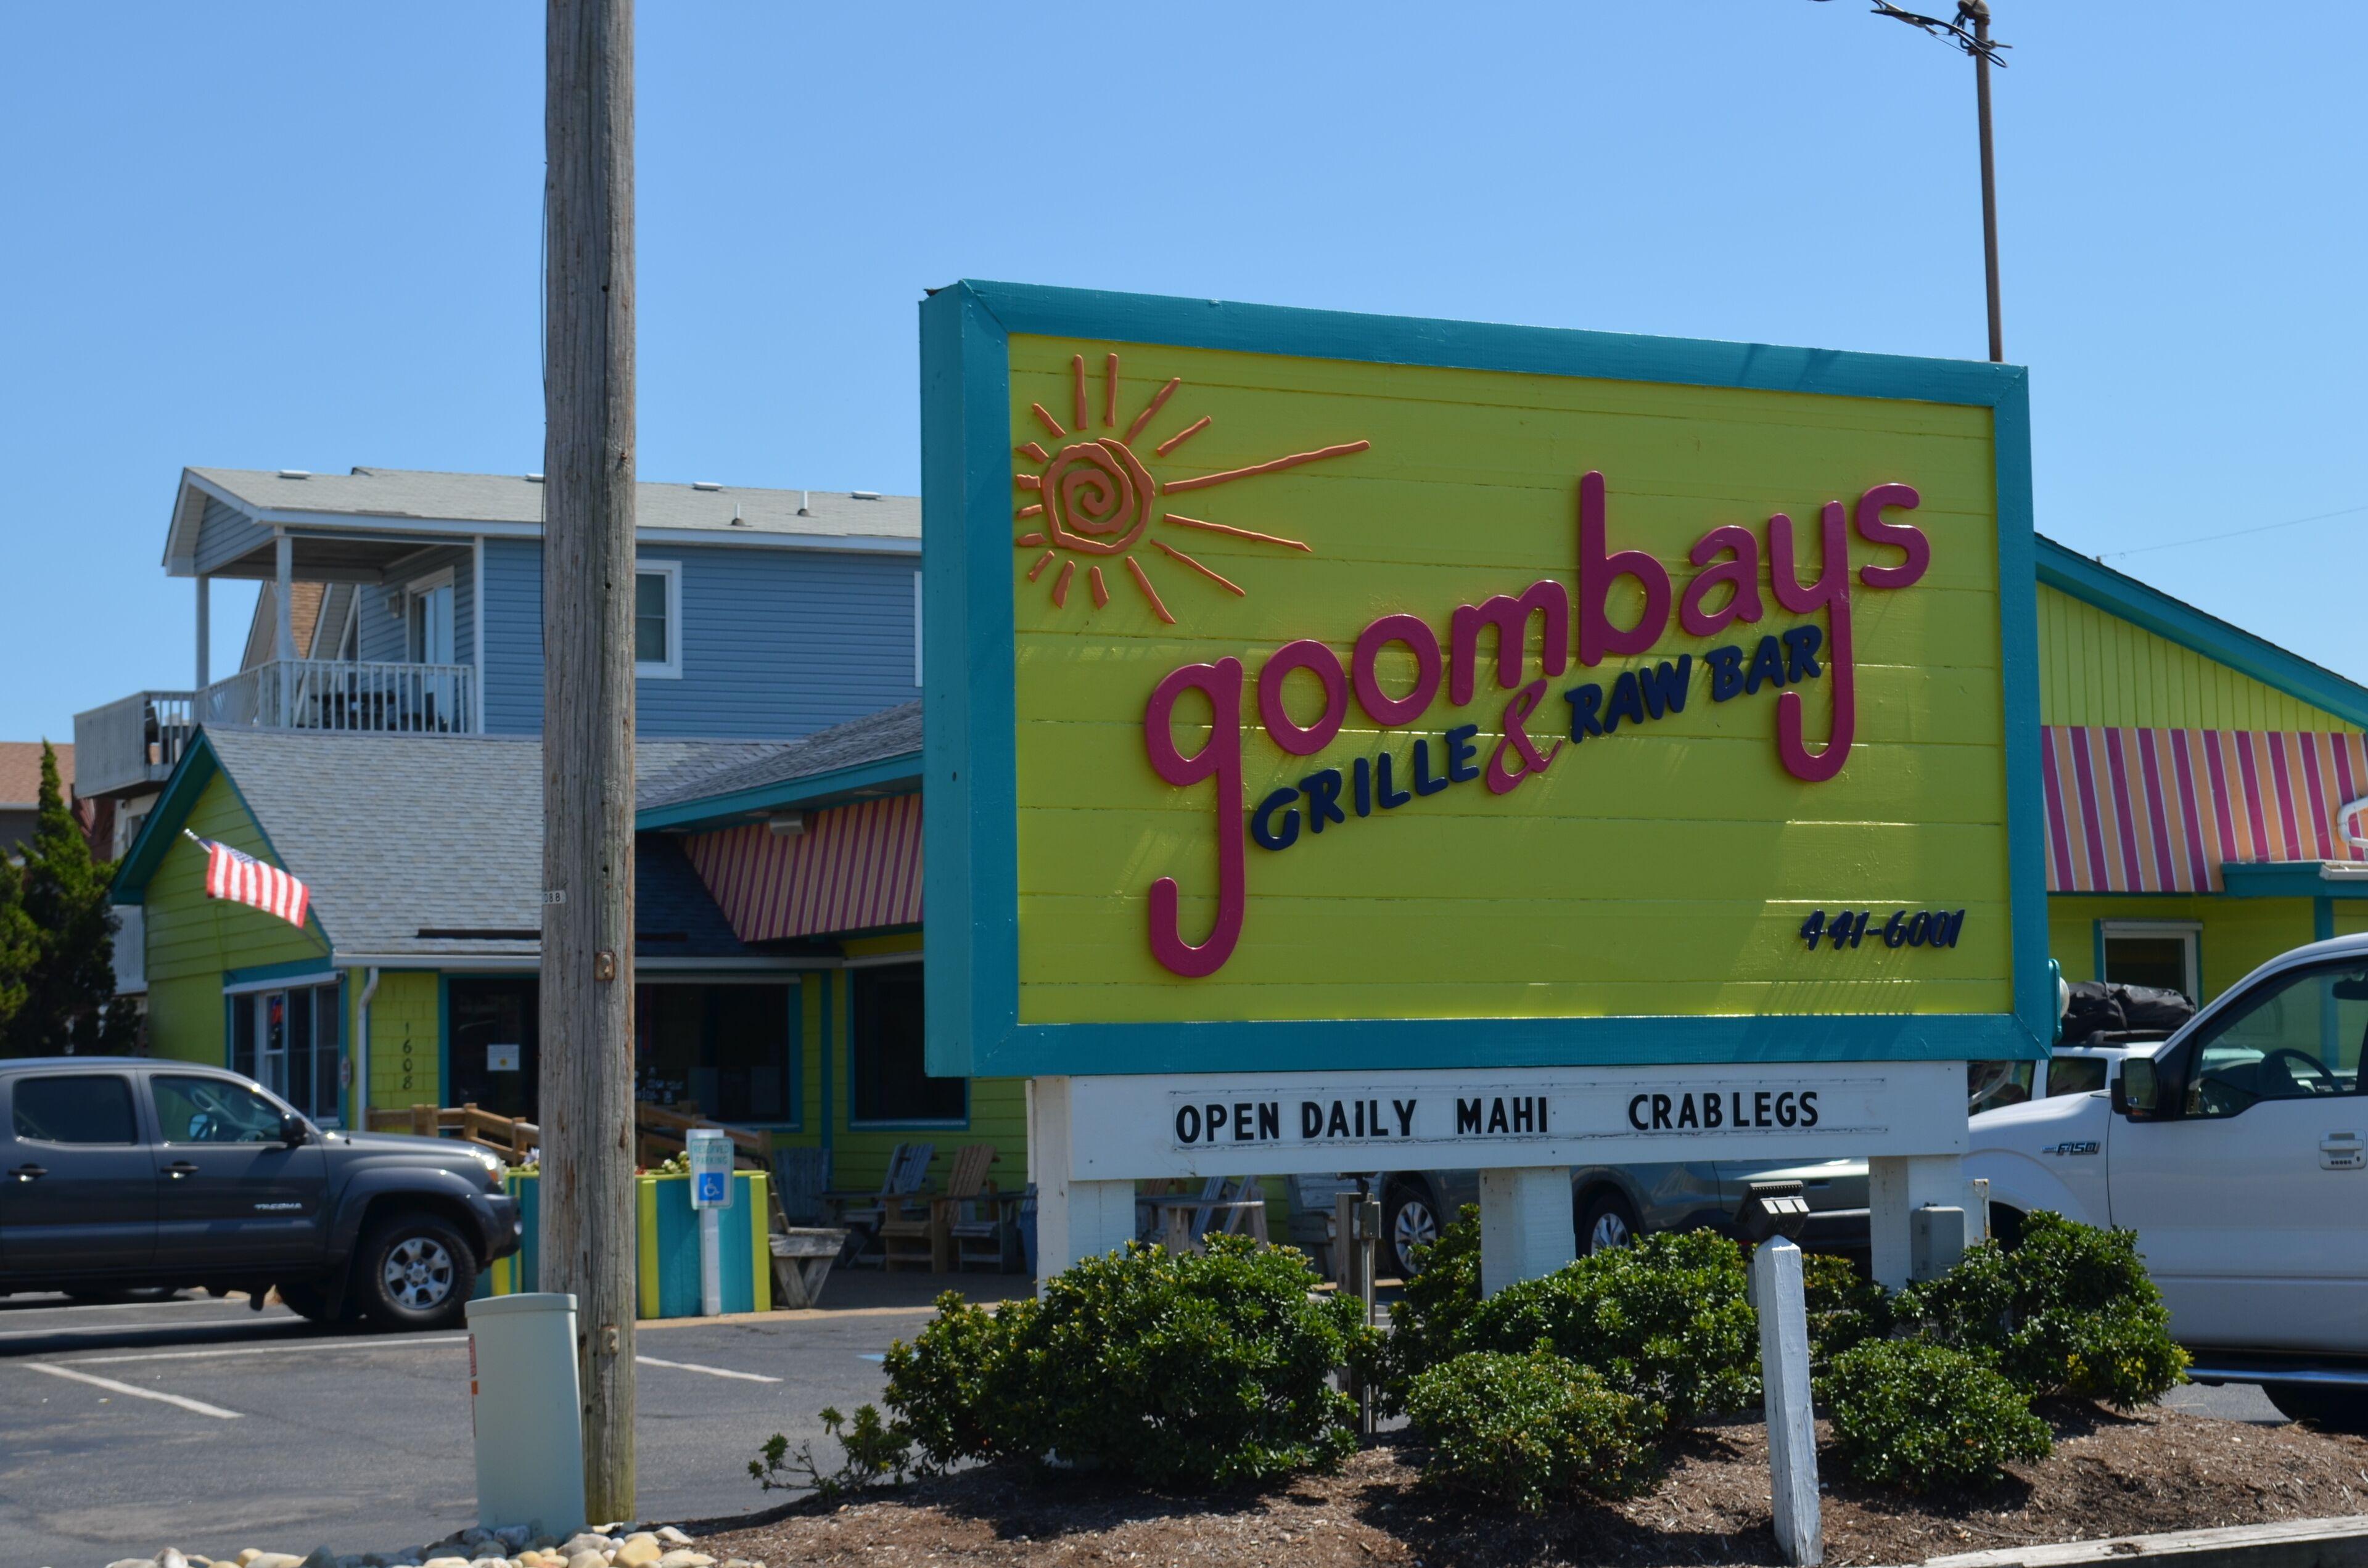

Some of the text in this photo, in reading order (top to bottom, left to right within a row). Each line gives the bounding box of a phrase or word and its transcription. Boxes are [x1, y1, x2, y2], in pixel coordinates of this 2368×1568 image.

[1145, 472, 1930, 977] goombays
[1252, 625, 1823, 851] GRILLE & RAW BAR
[1800, 909, 1965, 950] 441-6001
[1175, 1101, 1280, 1144] OPEN
[1301, 1099, 1417, 1139] DAILY
[1456, 1096, 1548, 1135] MAHI
